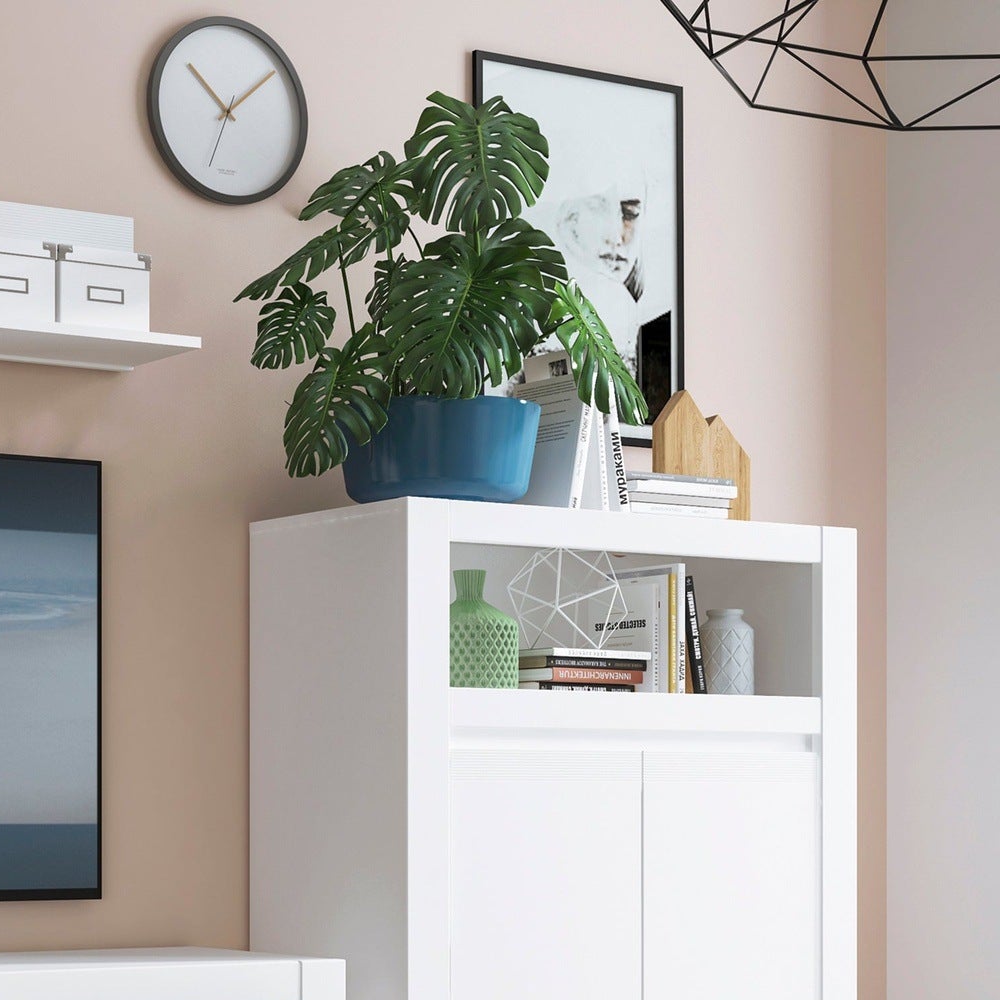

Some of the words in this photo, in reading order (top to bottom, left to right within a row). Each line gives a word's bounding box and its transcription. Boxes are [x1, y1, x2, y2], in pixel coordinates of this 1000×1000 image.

[610, 432, 628, 505] мураками
[618, 619, 647, 630] SELECTED
[559, 670, 632, 680] INNENARCHITEKTUR
